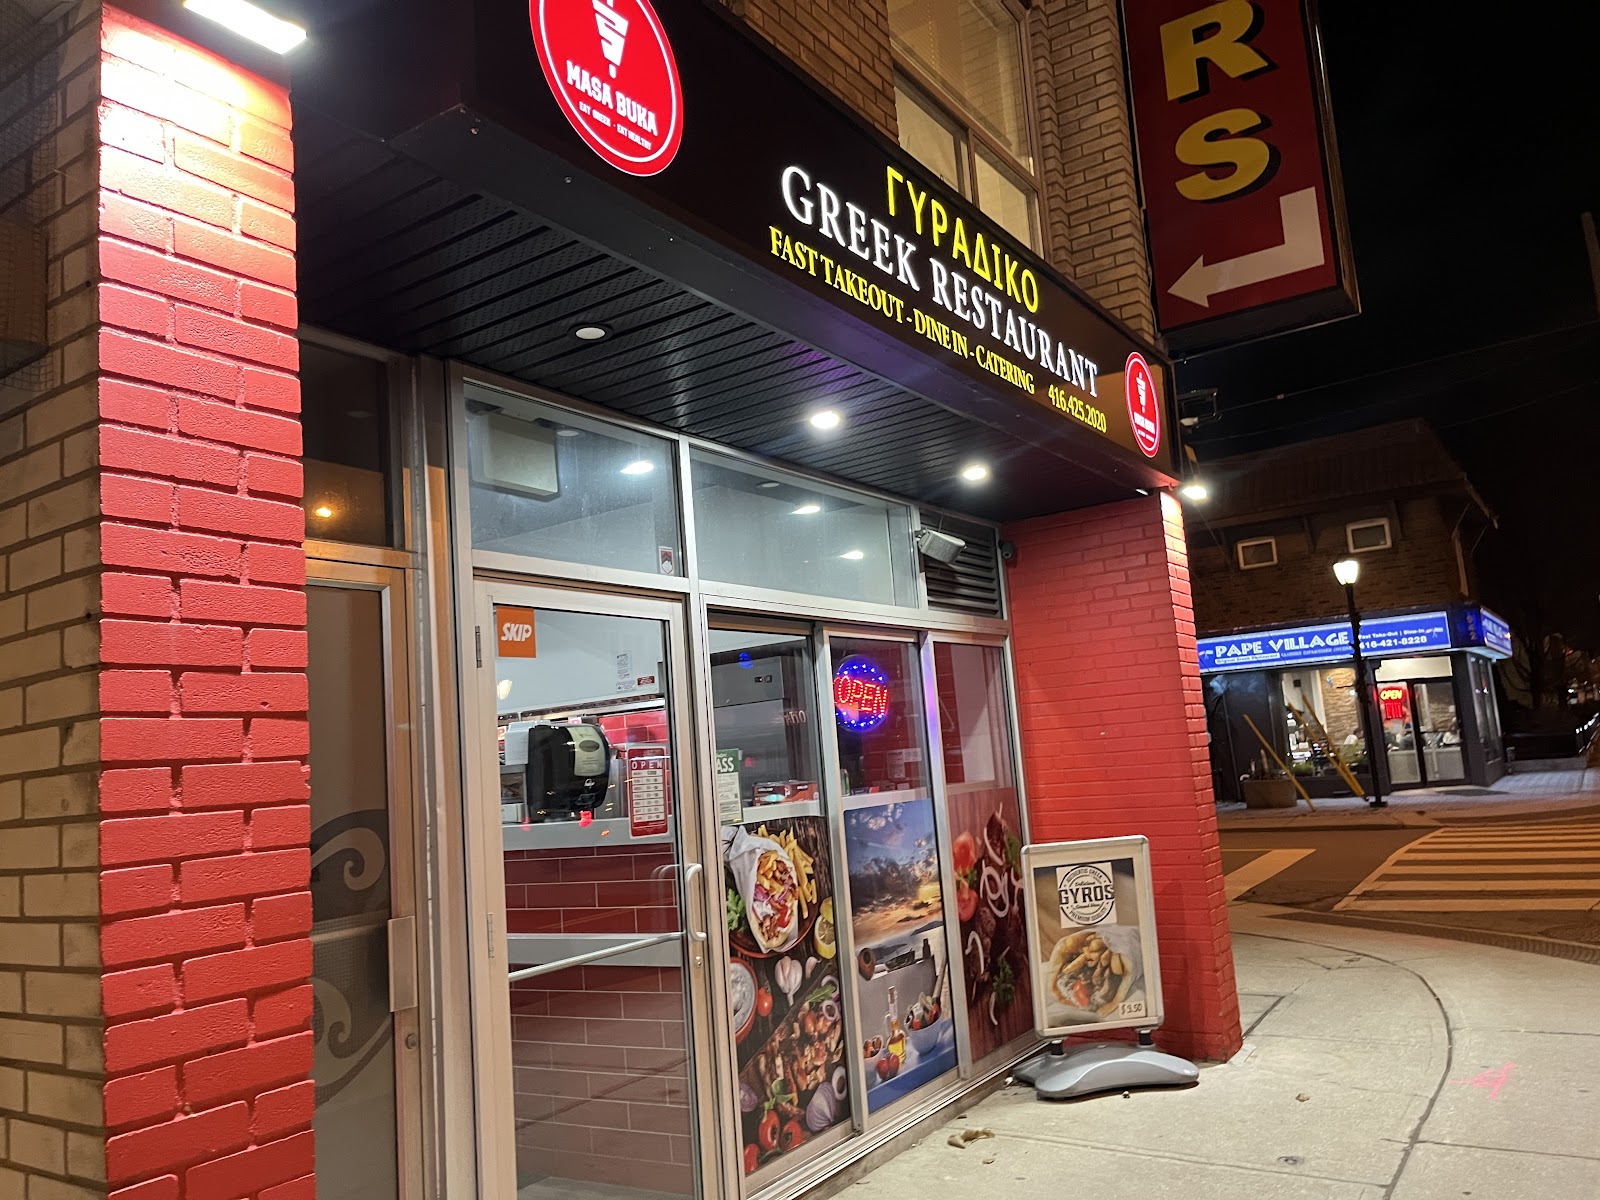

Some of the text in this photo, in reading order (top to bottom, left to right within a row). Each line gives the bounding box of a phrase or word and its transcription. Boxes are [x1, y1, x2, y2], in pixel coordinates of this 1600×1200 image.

[566, 60, 658, 137] MASA BUKA
[579, 100, 592, 115] EAT
[886, 165, 1039, 314] ΓΥΡΑΔΙΚΟ
[780, 165, 1098, 398] GREEK RESTAURANT
[769, 225, 818, 277] FAST
[820, 253, 904, 324] TAKEOUT
[913, 308, 952, 350] DINE
[951, 329, 969, 359] IN
[975, 345, 1035, 395] CATERING
[1048, 384, 1107, 433] 416.425.2020
[501, 623, 533, 642] SKIP
[1214, 641, 1263, 658] PAPE
[1268, 631, 1350, 652] VILLAGE
[838, 676, 888, 715] OPEN
[1380, 689, 1403, 701] OPEN
[631, 760, 663, 770] OPEN
[717, 757, 735, 773] ASS
[1058, 885, 1115, 905] GYROS
